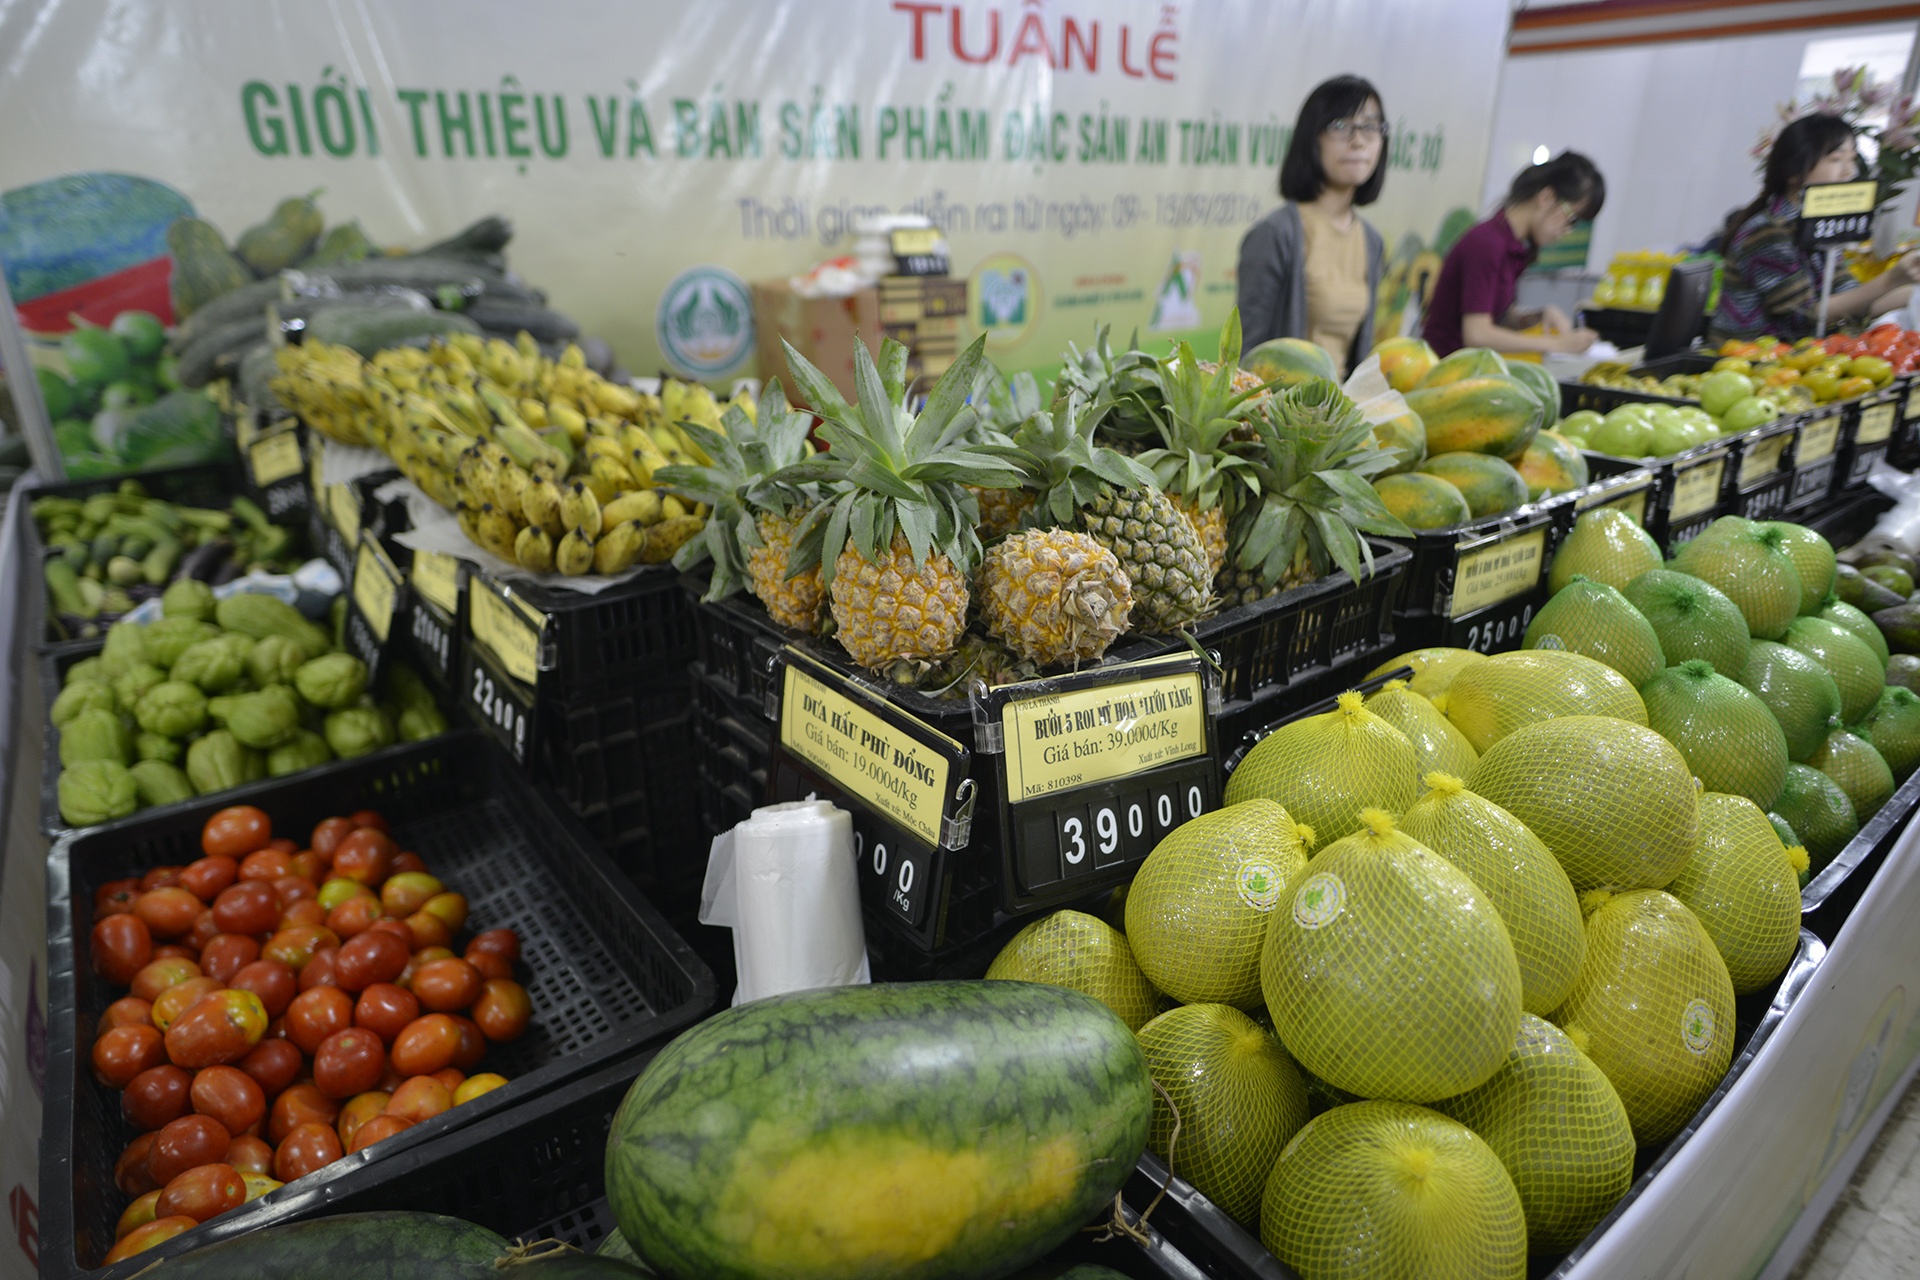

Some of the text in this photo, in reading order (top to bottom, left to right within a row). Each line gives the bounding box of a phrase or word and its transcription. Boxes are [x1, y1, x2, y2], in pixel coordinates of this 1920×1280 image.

[1119, 5, 1179, 82] LỄ
[241, 64, 378, 159] GIỚI
[396, 74, 569, 176] THIỆU
[586, 78, 655, 159] VÀ
[673, 82, 763, 160] BÁN
[878, 80, 990, 162] PHẨM
[1134, 117, 1168, 165] AN
[1175, 108, 1240, 168] TOÀN
[1467, 603, 1531, 652] 25000
[1034, 707, 1063, 740] BƯỞI
[1064, 712, 1074, 734] 5
[1074, 708, 1096, 736] ROI
[1167, 684, 1193, 710] VÀNG
[803, 693, 936, 788] DƯA HẤU PHÙ ĐỔNG
[1043, 719, 1179, 765] Giá bán: 39.000đ/Kg
[1180, 741, 1197, 752] Long
[805, 721, 918, 810] Giá bán: 19.000đ/kg
[1025, 773, 1083, 796] Mã: 810398
[917, 819, 936, 840] Châu
[893, 889, 910, 912] /Kg
